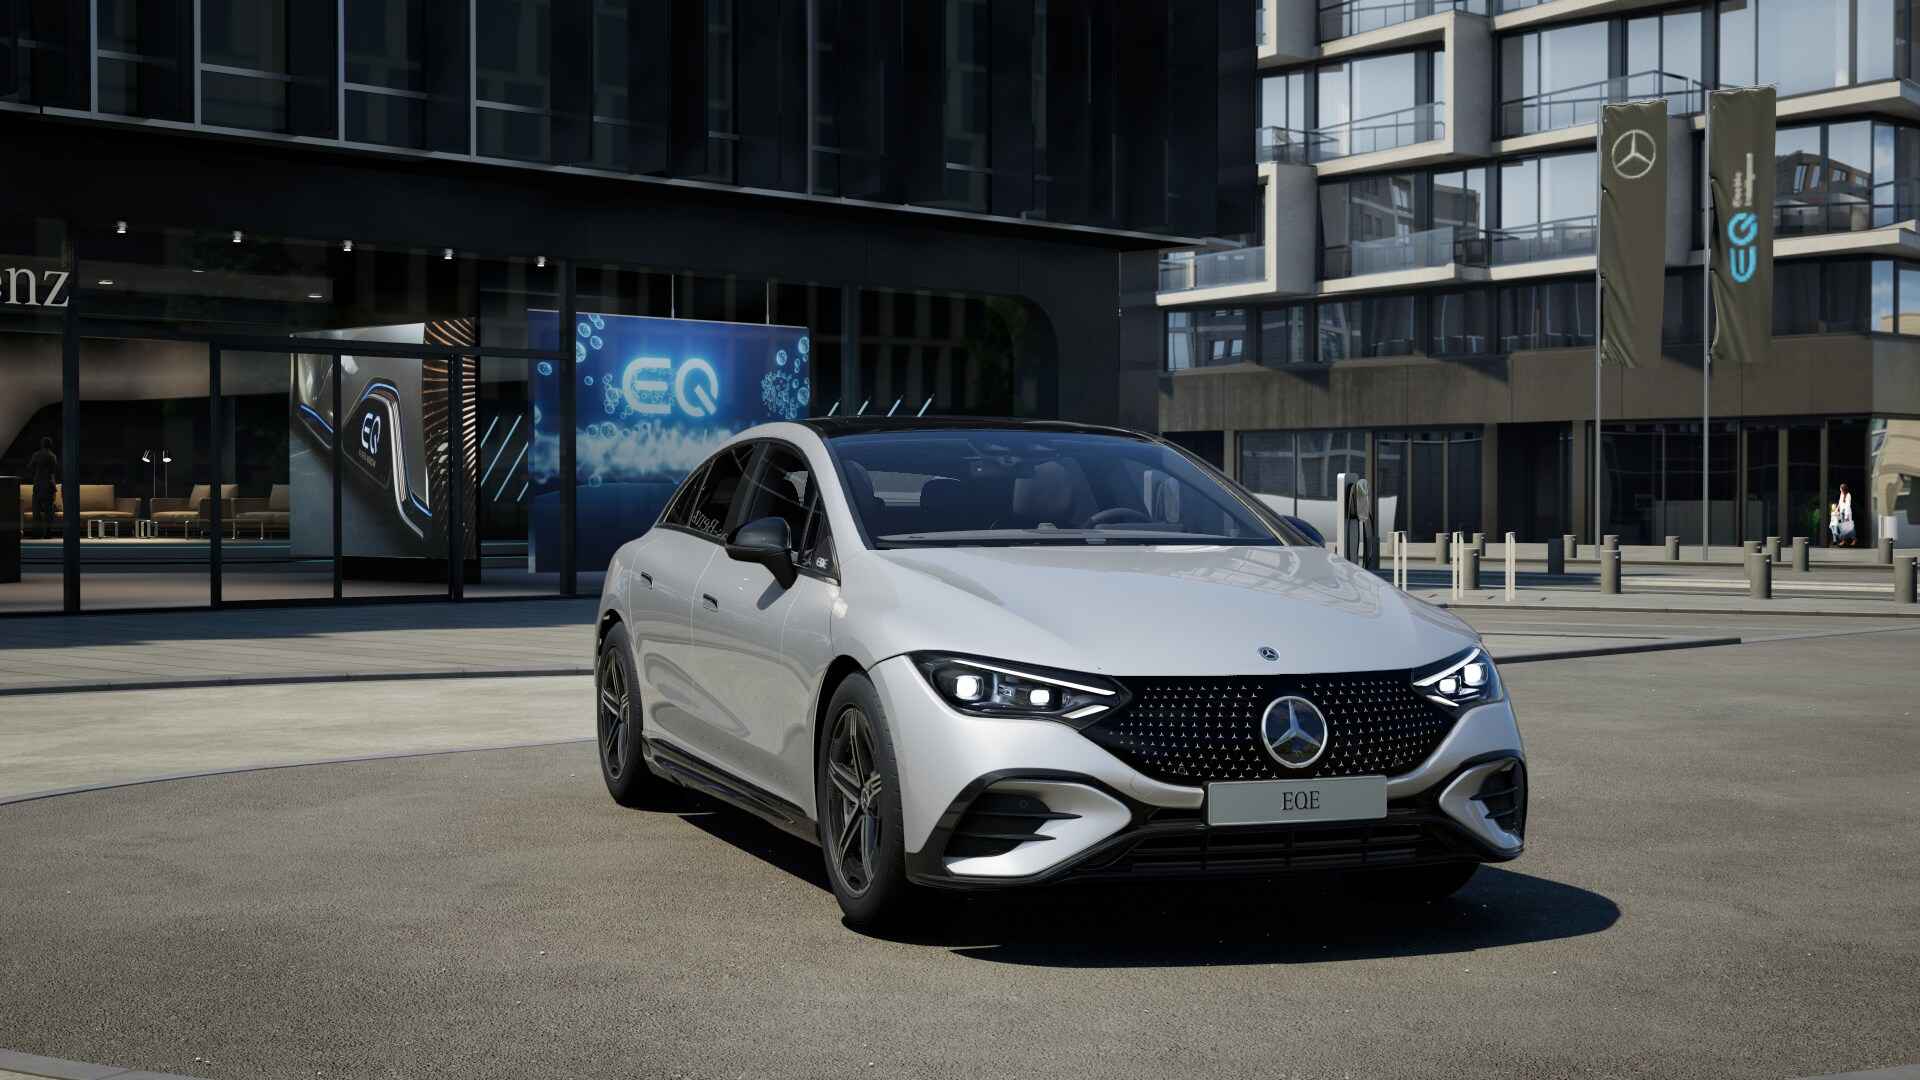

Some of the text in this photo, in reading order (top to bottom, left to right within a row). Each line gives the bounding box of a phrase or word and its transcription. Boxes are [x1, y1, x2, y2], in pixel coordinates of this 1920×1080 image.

[1728, 212, 1758, 284] EQ
[0, 267, 70, 307] nz
[622, 357, 719, 417] EQ
[361, 412, 381, 455] EQ
[1282, 791, 1320, 811] EQE
